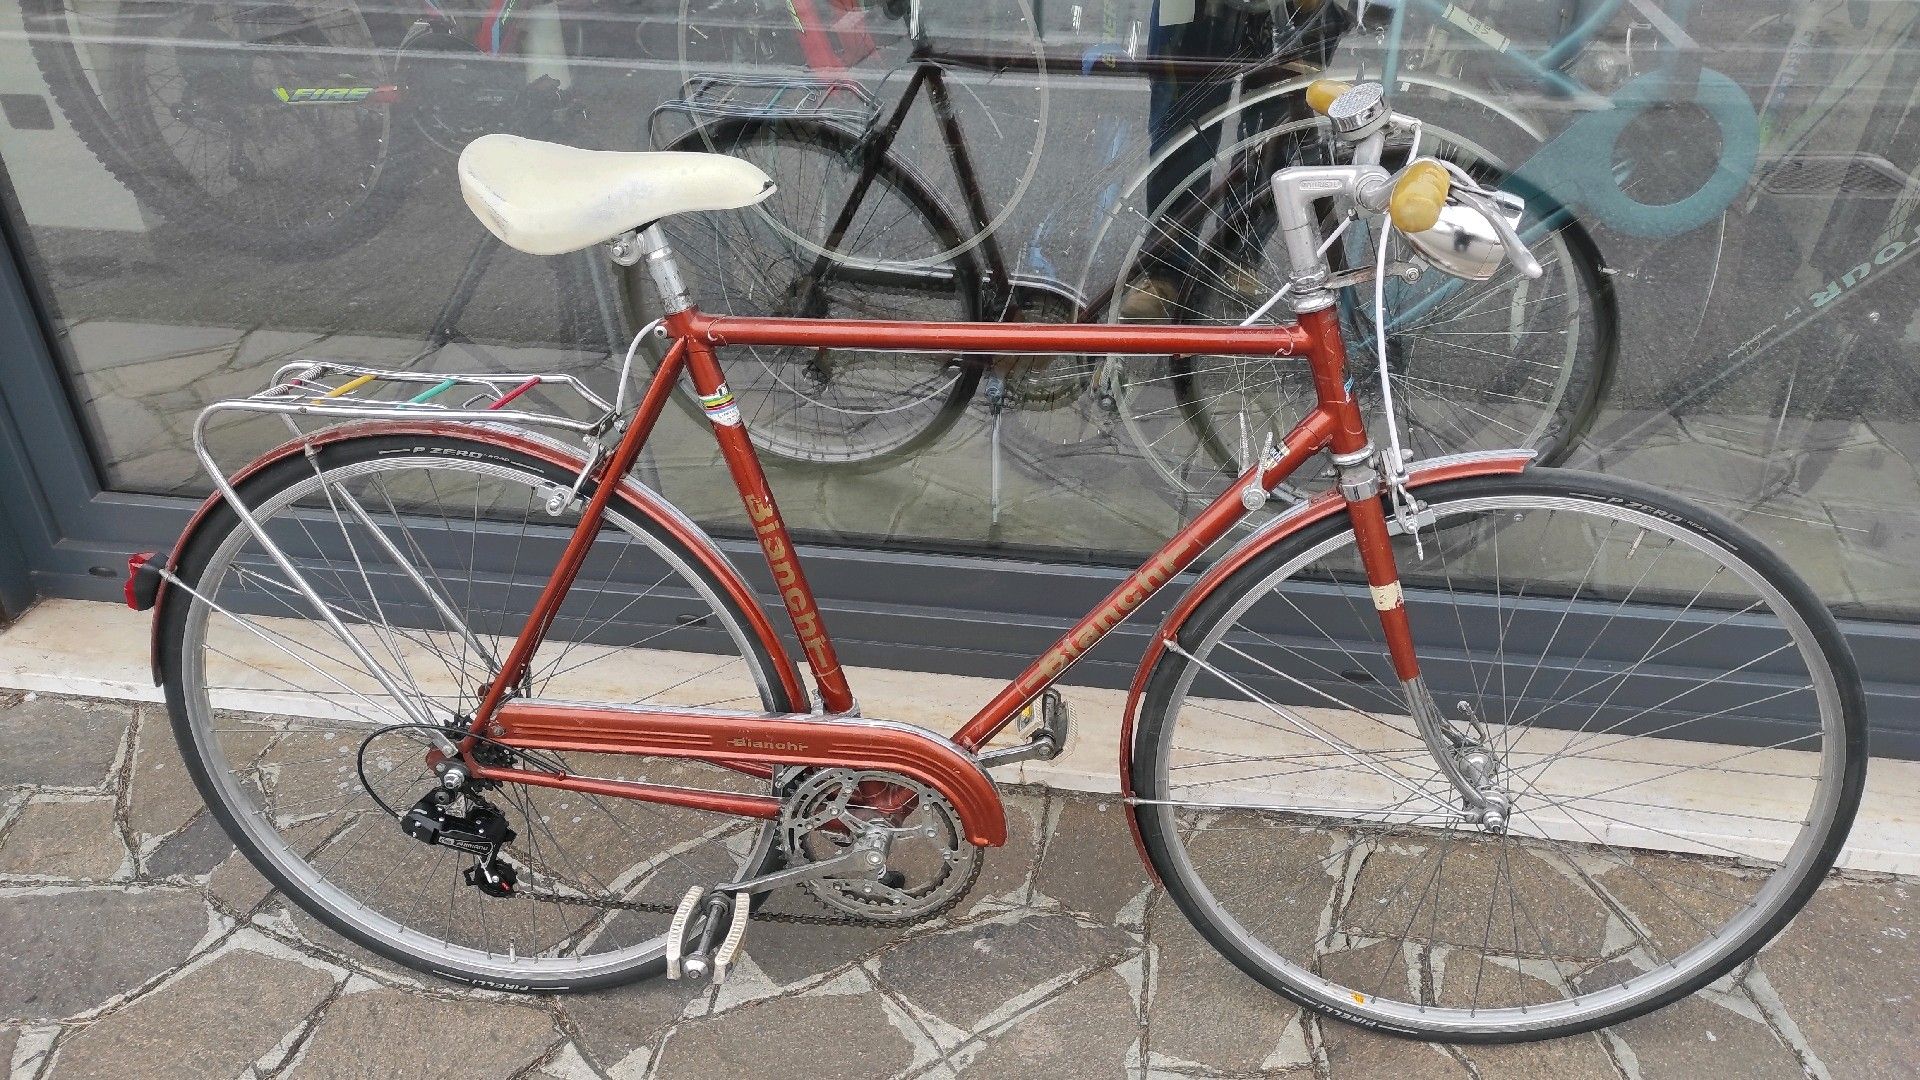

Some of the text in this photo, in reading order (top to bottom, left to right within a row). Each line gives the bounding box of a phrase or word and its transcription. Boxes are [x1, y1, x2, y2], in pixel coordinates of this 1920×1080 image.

[429, 446, 484, 459] ZERO
[1625, 501, 1683, 523] ZERO
[471, 979, 529, 991] PIRELLI
[1317, 1003, 1377, 1027] PIRELLI
